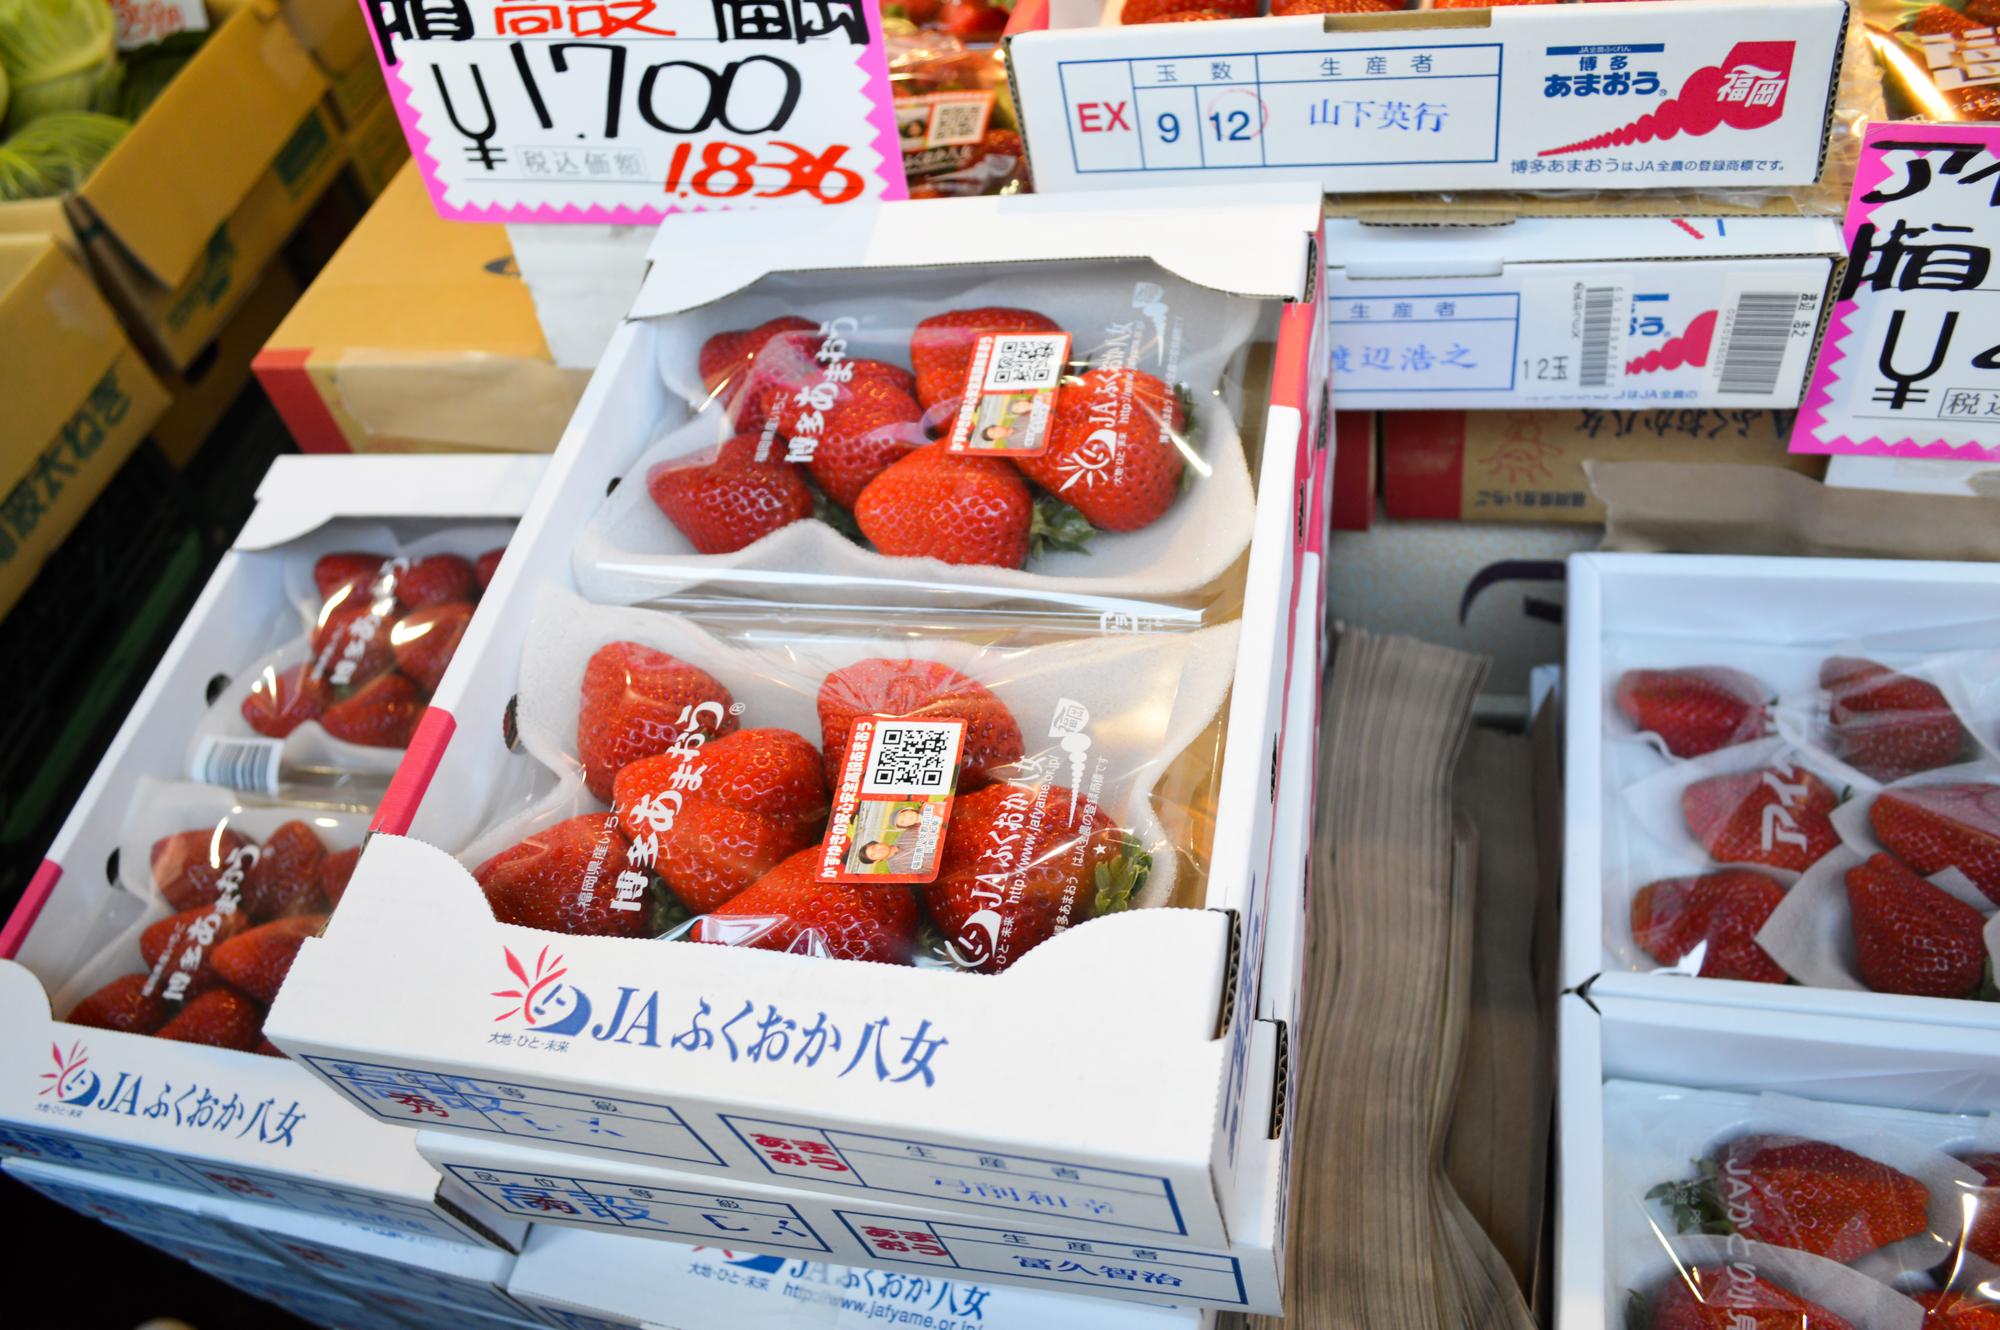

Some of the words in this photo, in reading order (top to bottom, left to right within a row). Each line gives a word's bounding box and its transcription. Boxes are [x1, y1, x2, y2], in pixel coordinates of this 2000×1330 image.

[1155, 61, 1233, 82] 玉数
[1319, 54, 1435, 77] 生産者
[1579, 56, 1628, 71] 博多
[1543, 72, 1660, 98] あまおう
[1077, 101, 1130, 133] EX
[1157, 112, 1180, 144] 9
[1209, 110, 1251, 142] 12
[1309, 97, 1449, 133] 山下英行
[1350, 301, 1456, 318] 生産者
[609, 700, 725, 912] 博多あまおう
[1001, 1232, 1161, 1260] 生産者
